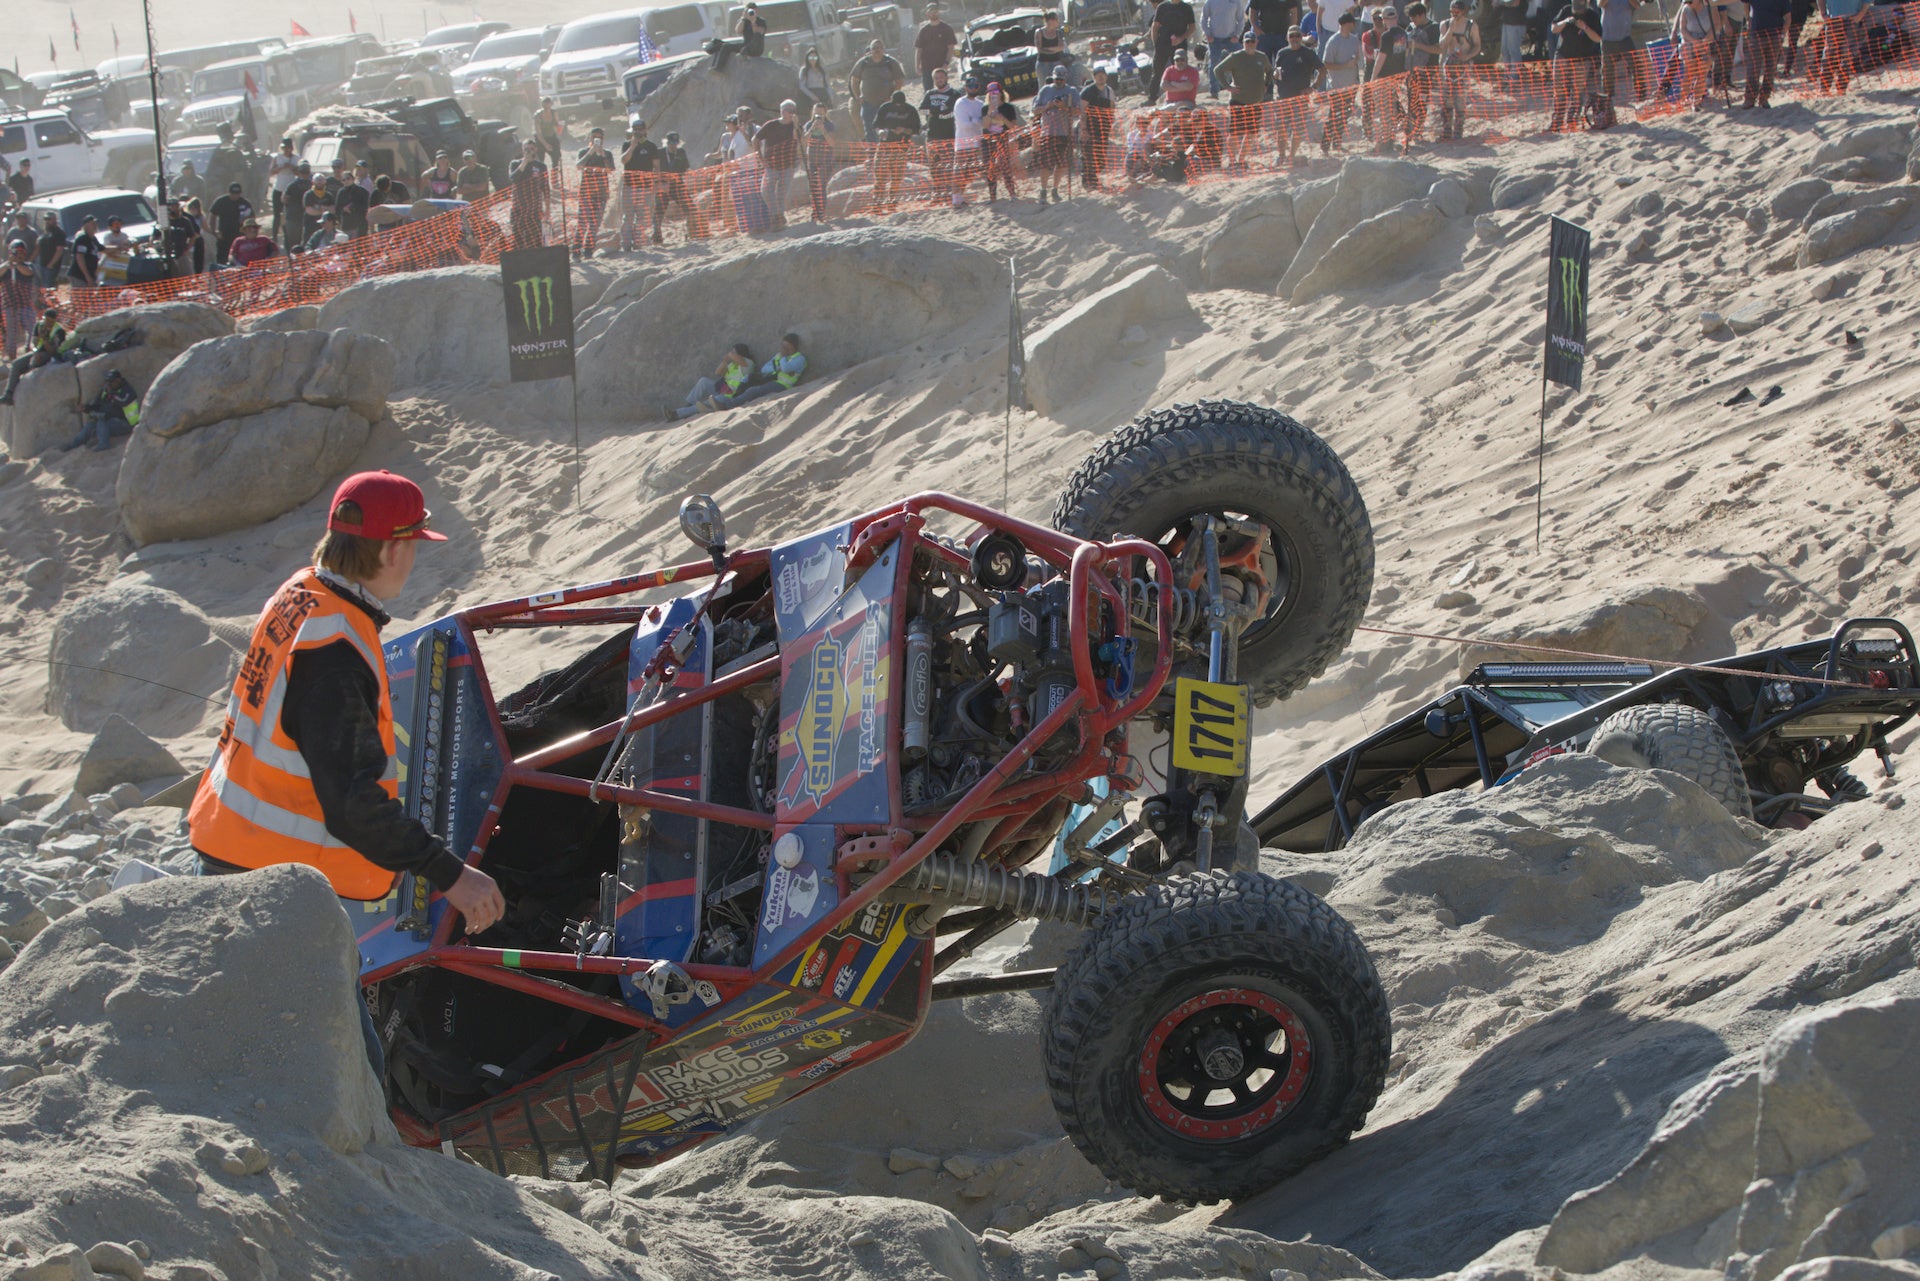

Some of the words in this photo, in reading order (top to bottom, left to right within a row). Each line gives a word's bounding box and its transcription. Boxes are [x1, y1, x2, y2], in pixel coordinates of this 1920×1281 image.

[511, 339, 567, 354] MONSTER
[781, 568, 794, 612] Yukon
[861, 600, 882, 690] FUELS
[916, 658, 928, 709] radflo
[450, 679, 464, 780] MOTORSPORTS
[811, 650, 836, 786] SUNOCO
[858, 692, 877, 777] RACE
[1189, 690, 1235, 760] 1717
[446, 786, 457, 849] LEMETRY
[765, 871, 784, 926] Yukon
[443, 1009, 453, 1032] EVO
[734, 1008, 796, 1035] SUNOCO
[747, 1033, 781, 1049] RACE
[783, 1020, 819, 1038] FUELS
[655, 1047, 738, 1083] RACE
[666, 1050, 786, 1097] RADIOS
